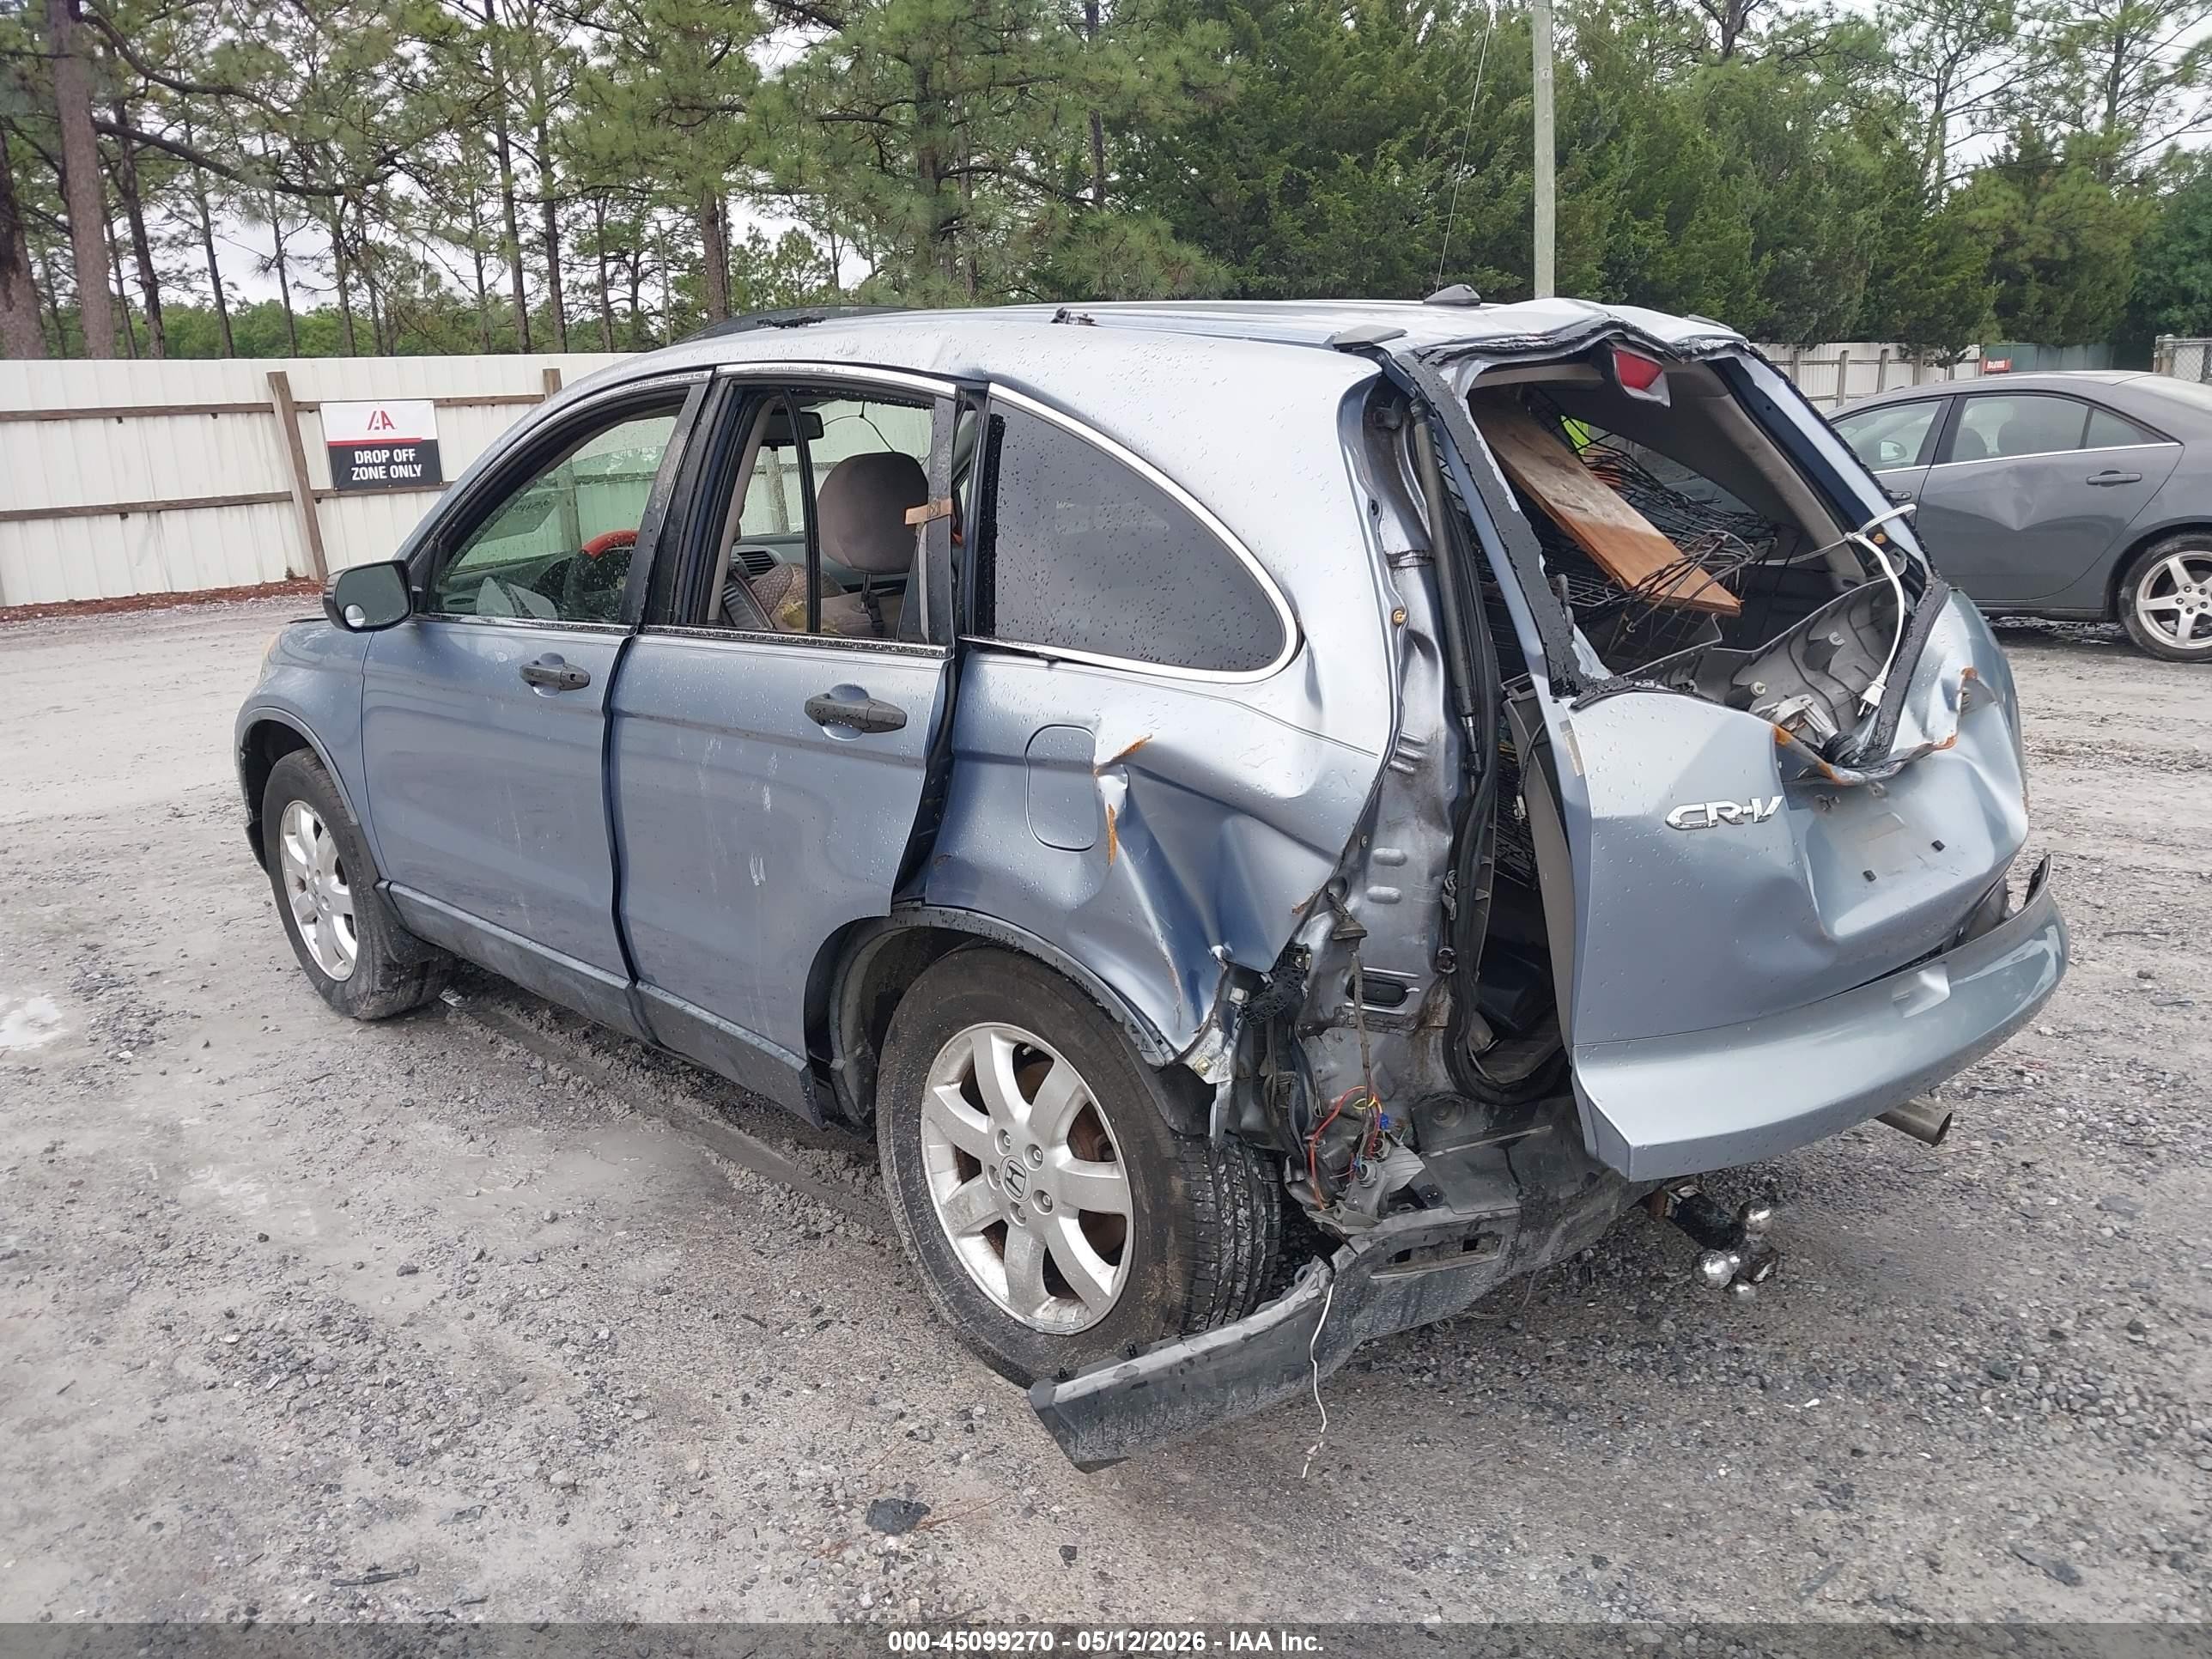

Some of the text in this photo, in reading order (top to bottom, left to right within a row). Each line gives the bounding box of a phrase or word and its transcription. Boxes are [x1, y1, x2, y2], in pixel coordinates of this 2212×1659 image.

[355, 448, 416, 465] DROP OFF
[351, 464, 422, 481] ZONE ONLY
[1665, 795, 1784, 830] CR-V
